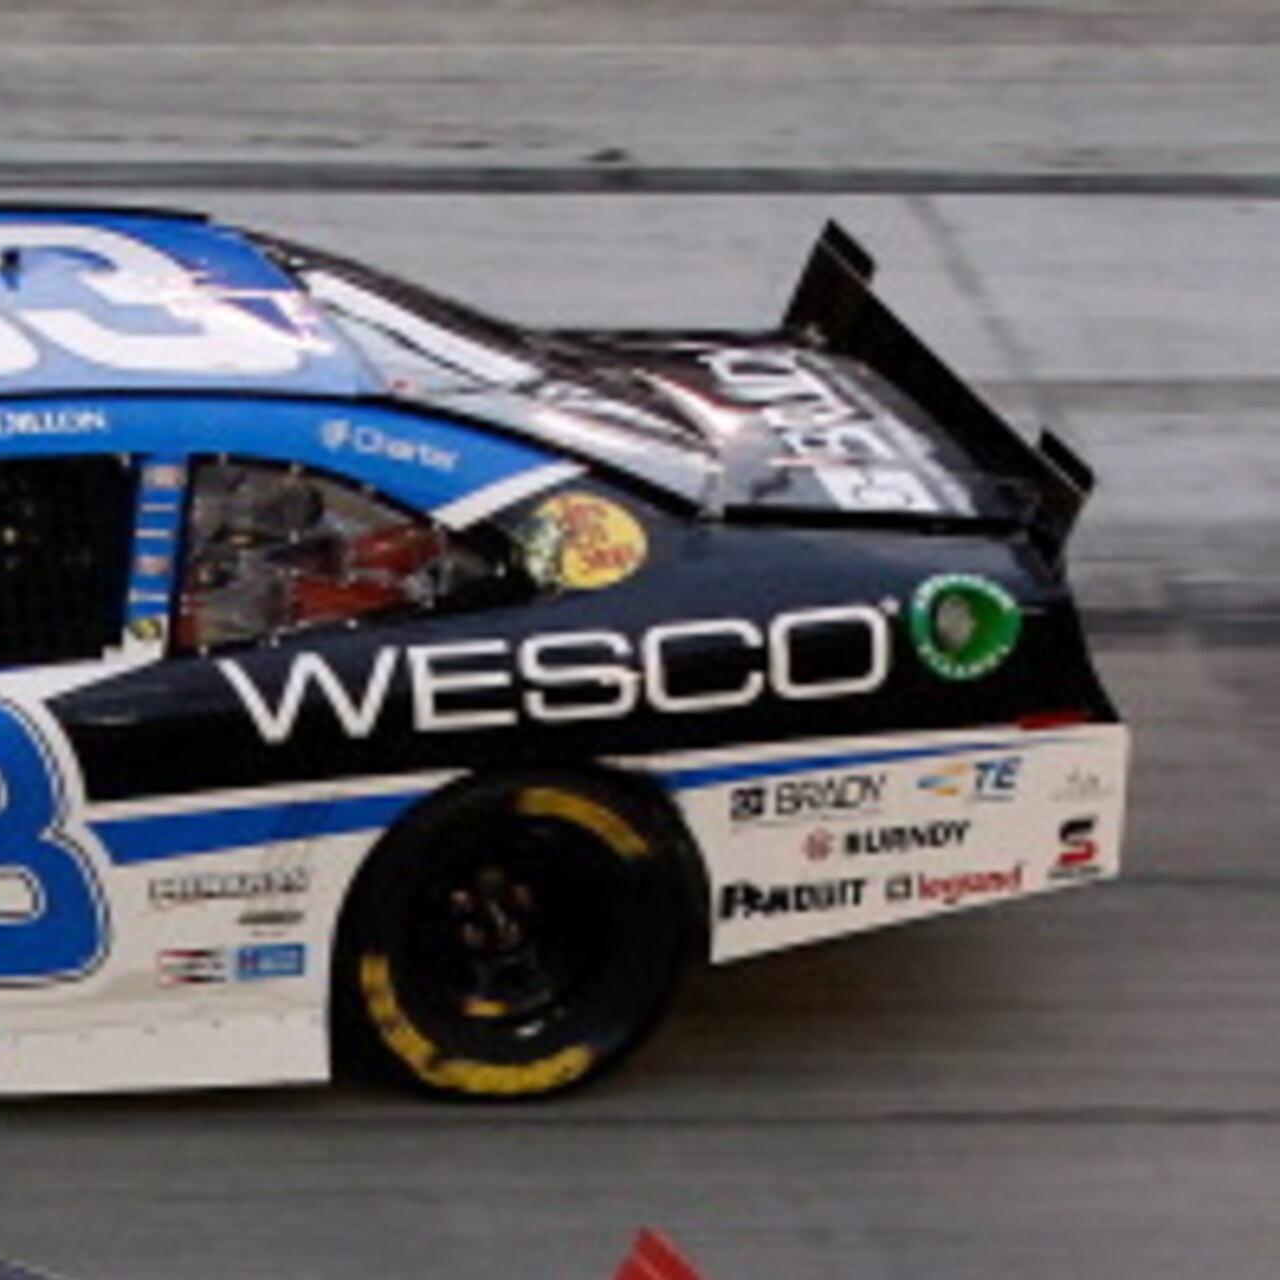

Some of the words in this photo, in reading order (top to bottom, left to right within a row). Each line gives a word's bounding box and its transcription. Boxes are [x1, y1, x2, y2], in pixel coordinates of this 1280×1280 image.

[218, 605, 892, 742] WESCO
[775, 773, 887, 815] BRADY
[917, 862, 1026, 905] legrand
